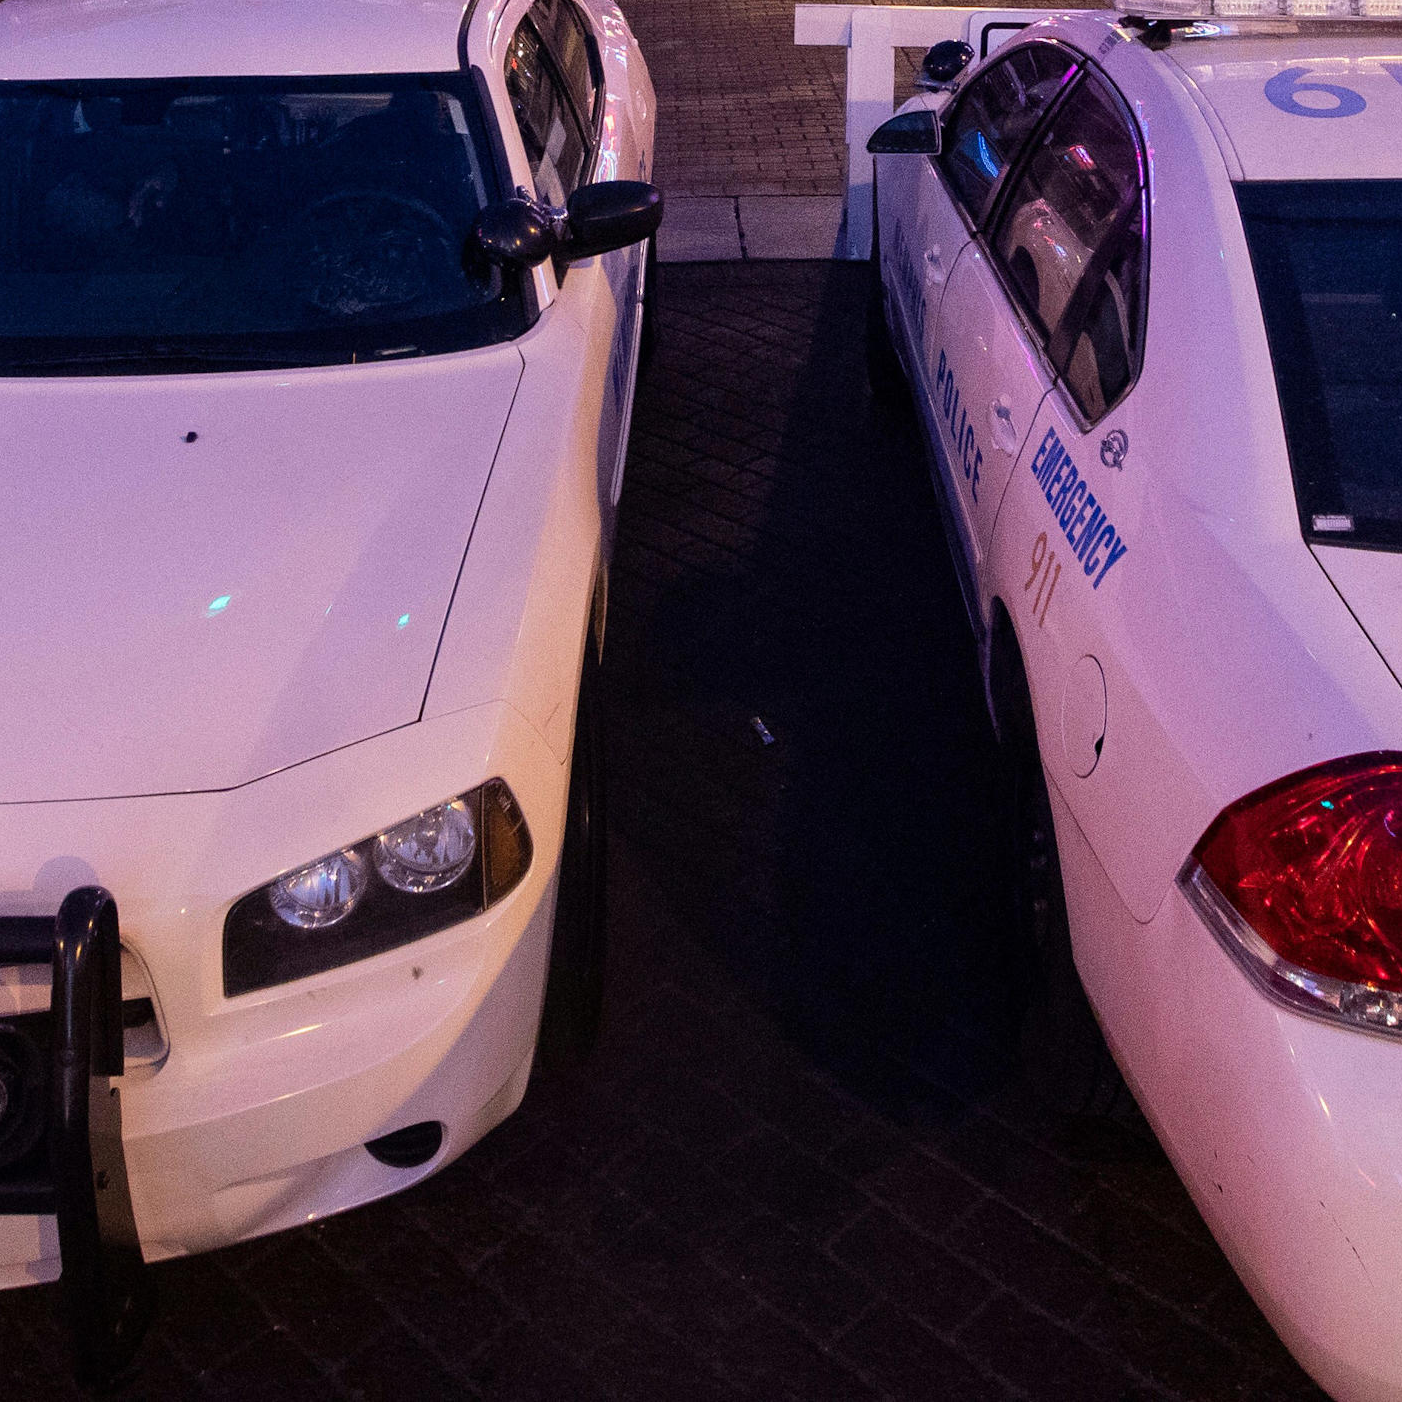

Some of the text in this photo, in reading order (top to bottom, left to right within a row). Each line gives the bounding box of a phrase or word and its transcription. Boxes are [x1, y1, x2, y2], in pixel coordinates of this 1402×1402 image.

[936, 348, 983, 503] POLICE
[1024, 531, 1061, 628] 911
[1030, 426, 1128, 590] EMERGENCY
